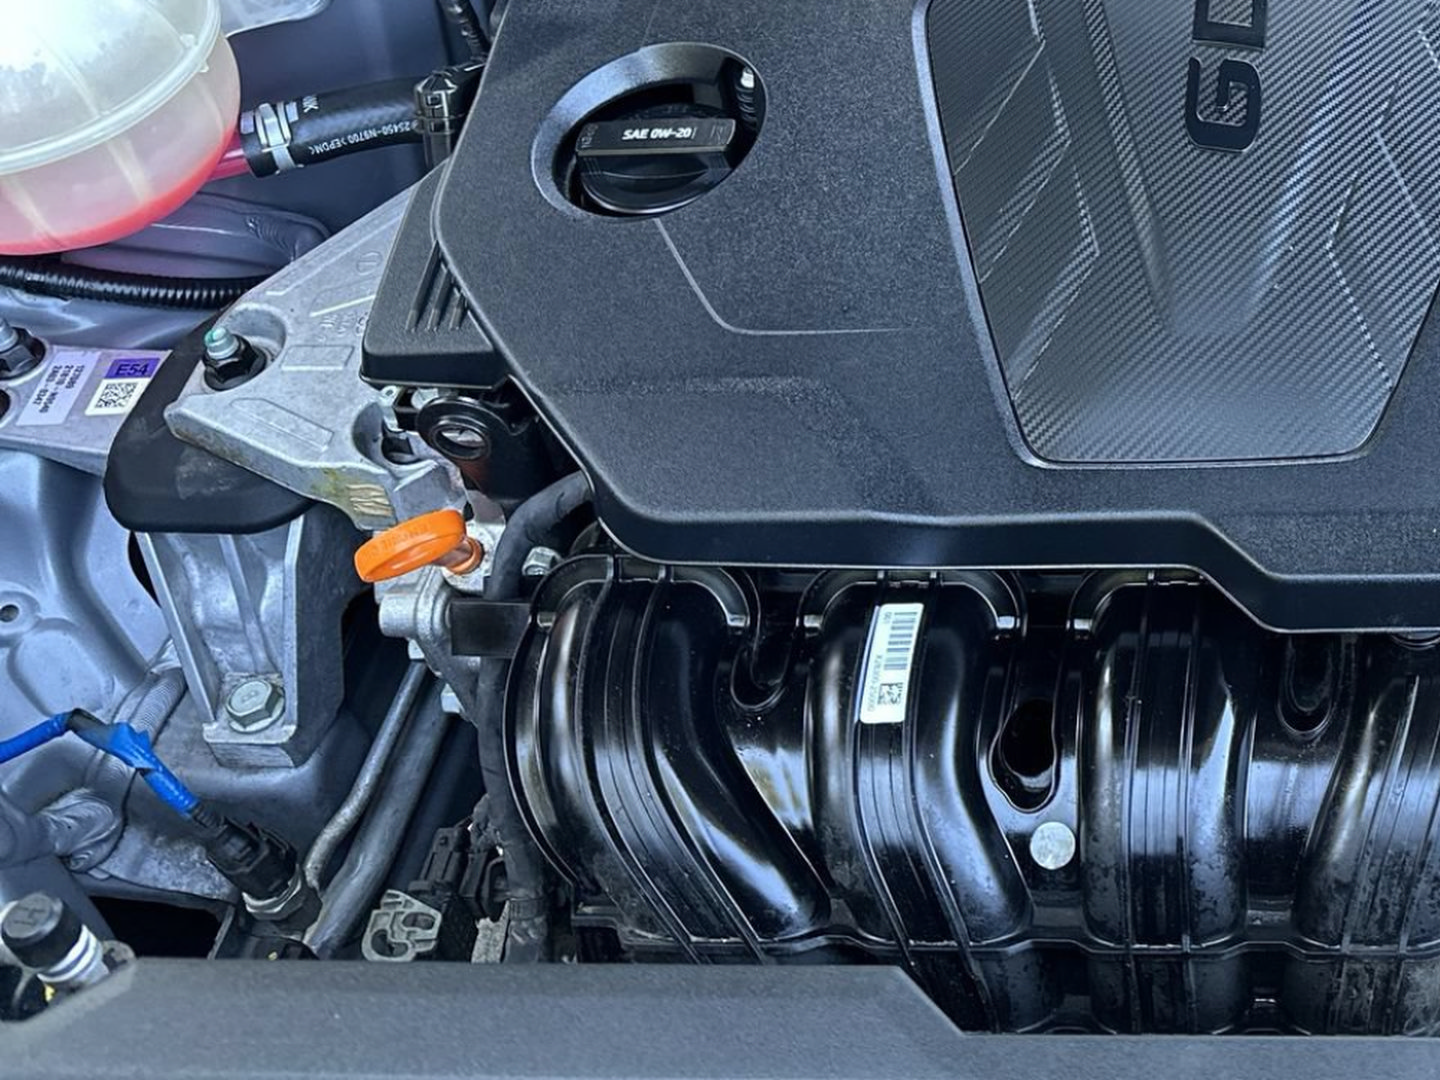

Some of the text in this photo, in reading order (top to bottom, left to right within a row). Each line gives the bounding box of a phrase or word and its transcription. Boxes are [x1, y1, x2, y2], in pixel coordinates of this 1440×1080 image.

[621, 126, 692, 140] SAE 0W-20
[116, 363, 150, 376] E54
